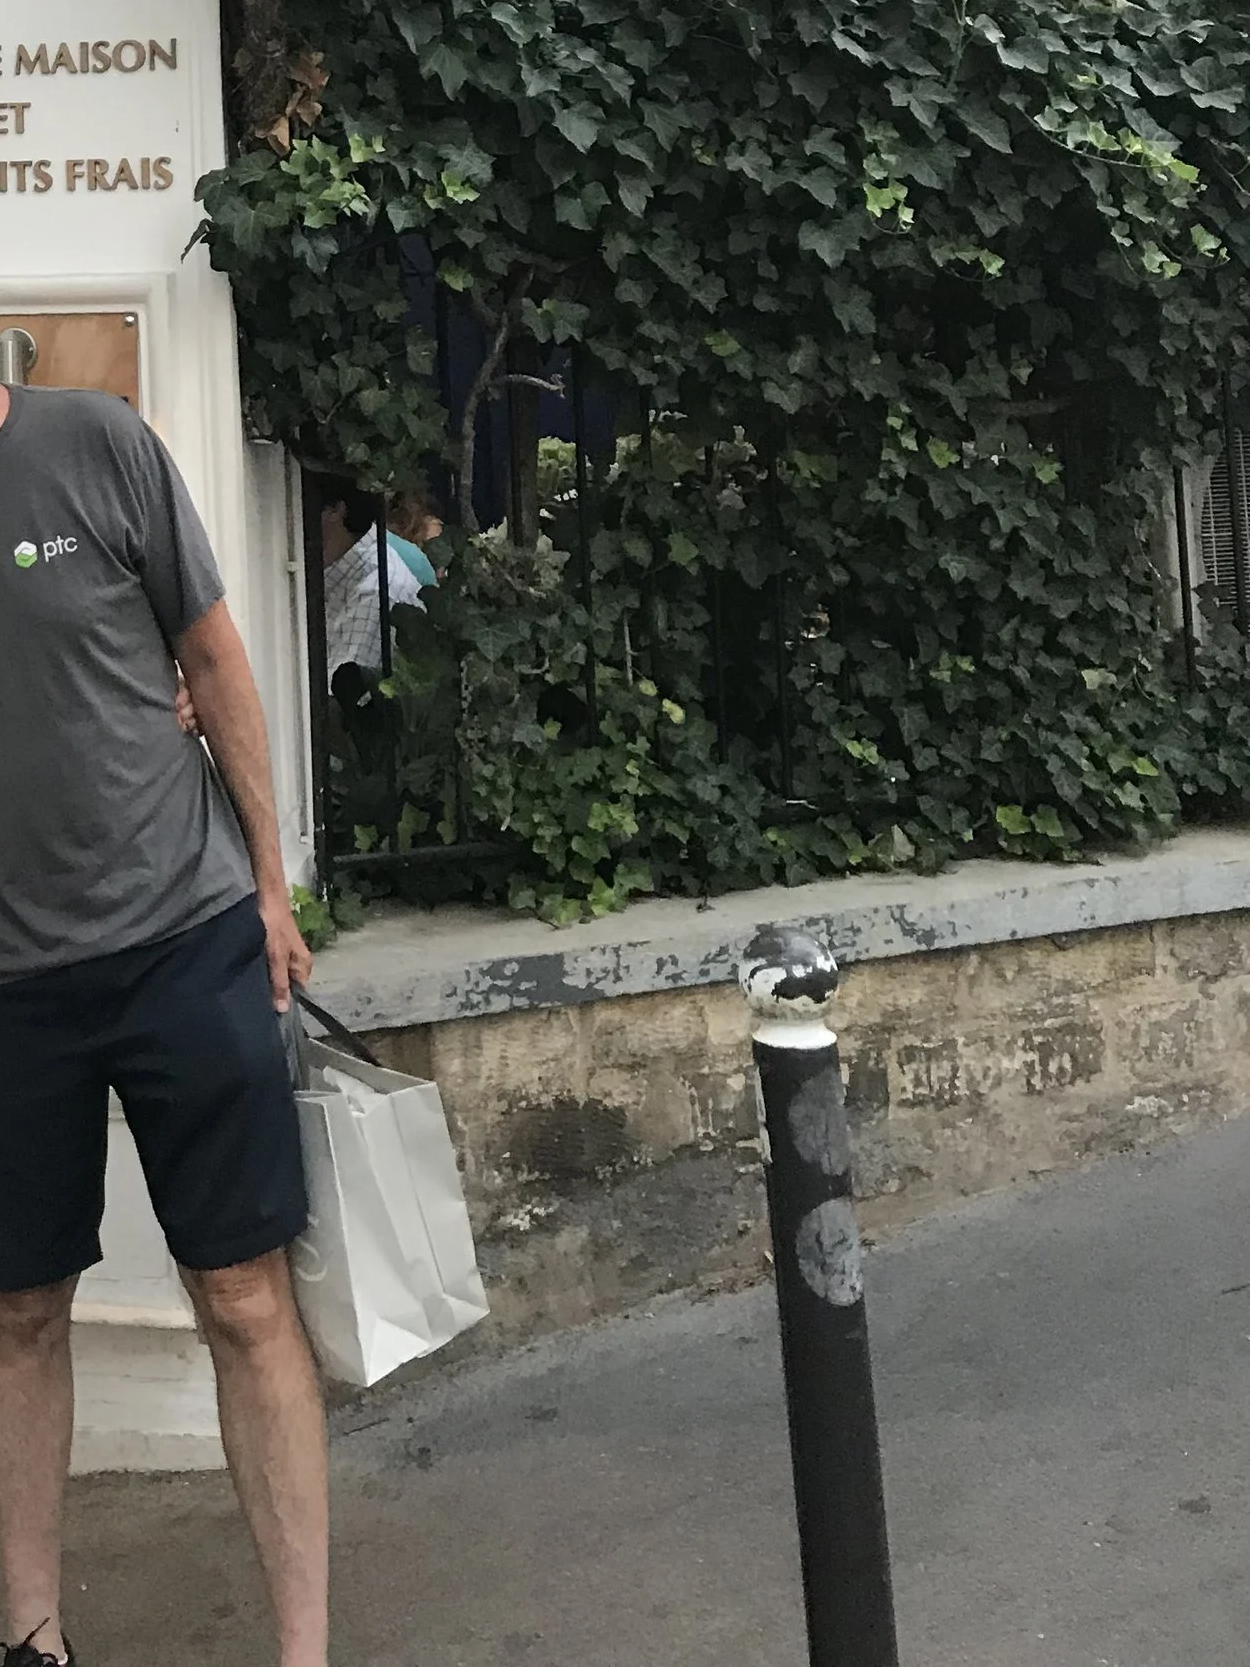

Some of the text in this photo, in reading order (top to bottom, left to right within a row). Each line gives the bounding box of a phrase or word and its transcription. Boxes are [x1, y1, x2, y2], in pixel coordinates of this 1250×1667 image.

[14, 37, 177, 76] MAISON
[66, 156, 174, 191] FRAIS
[43, 535, 78, 563] ptc
